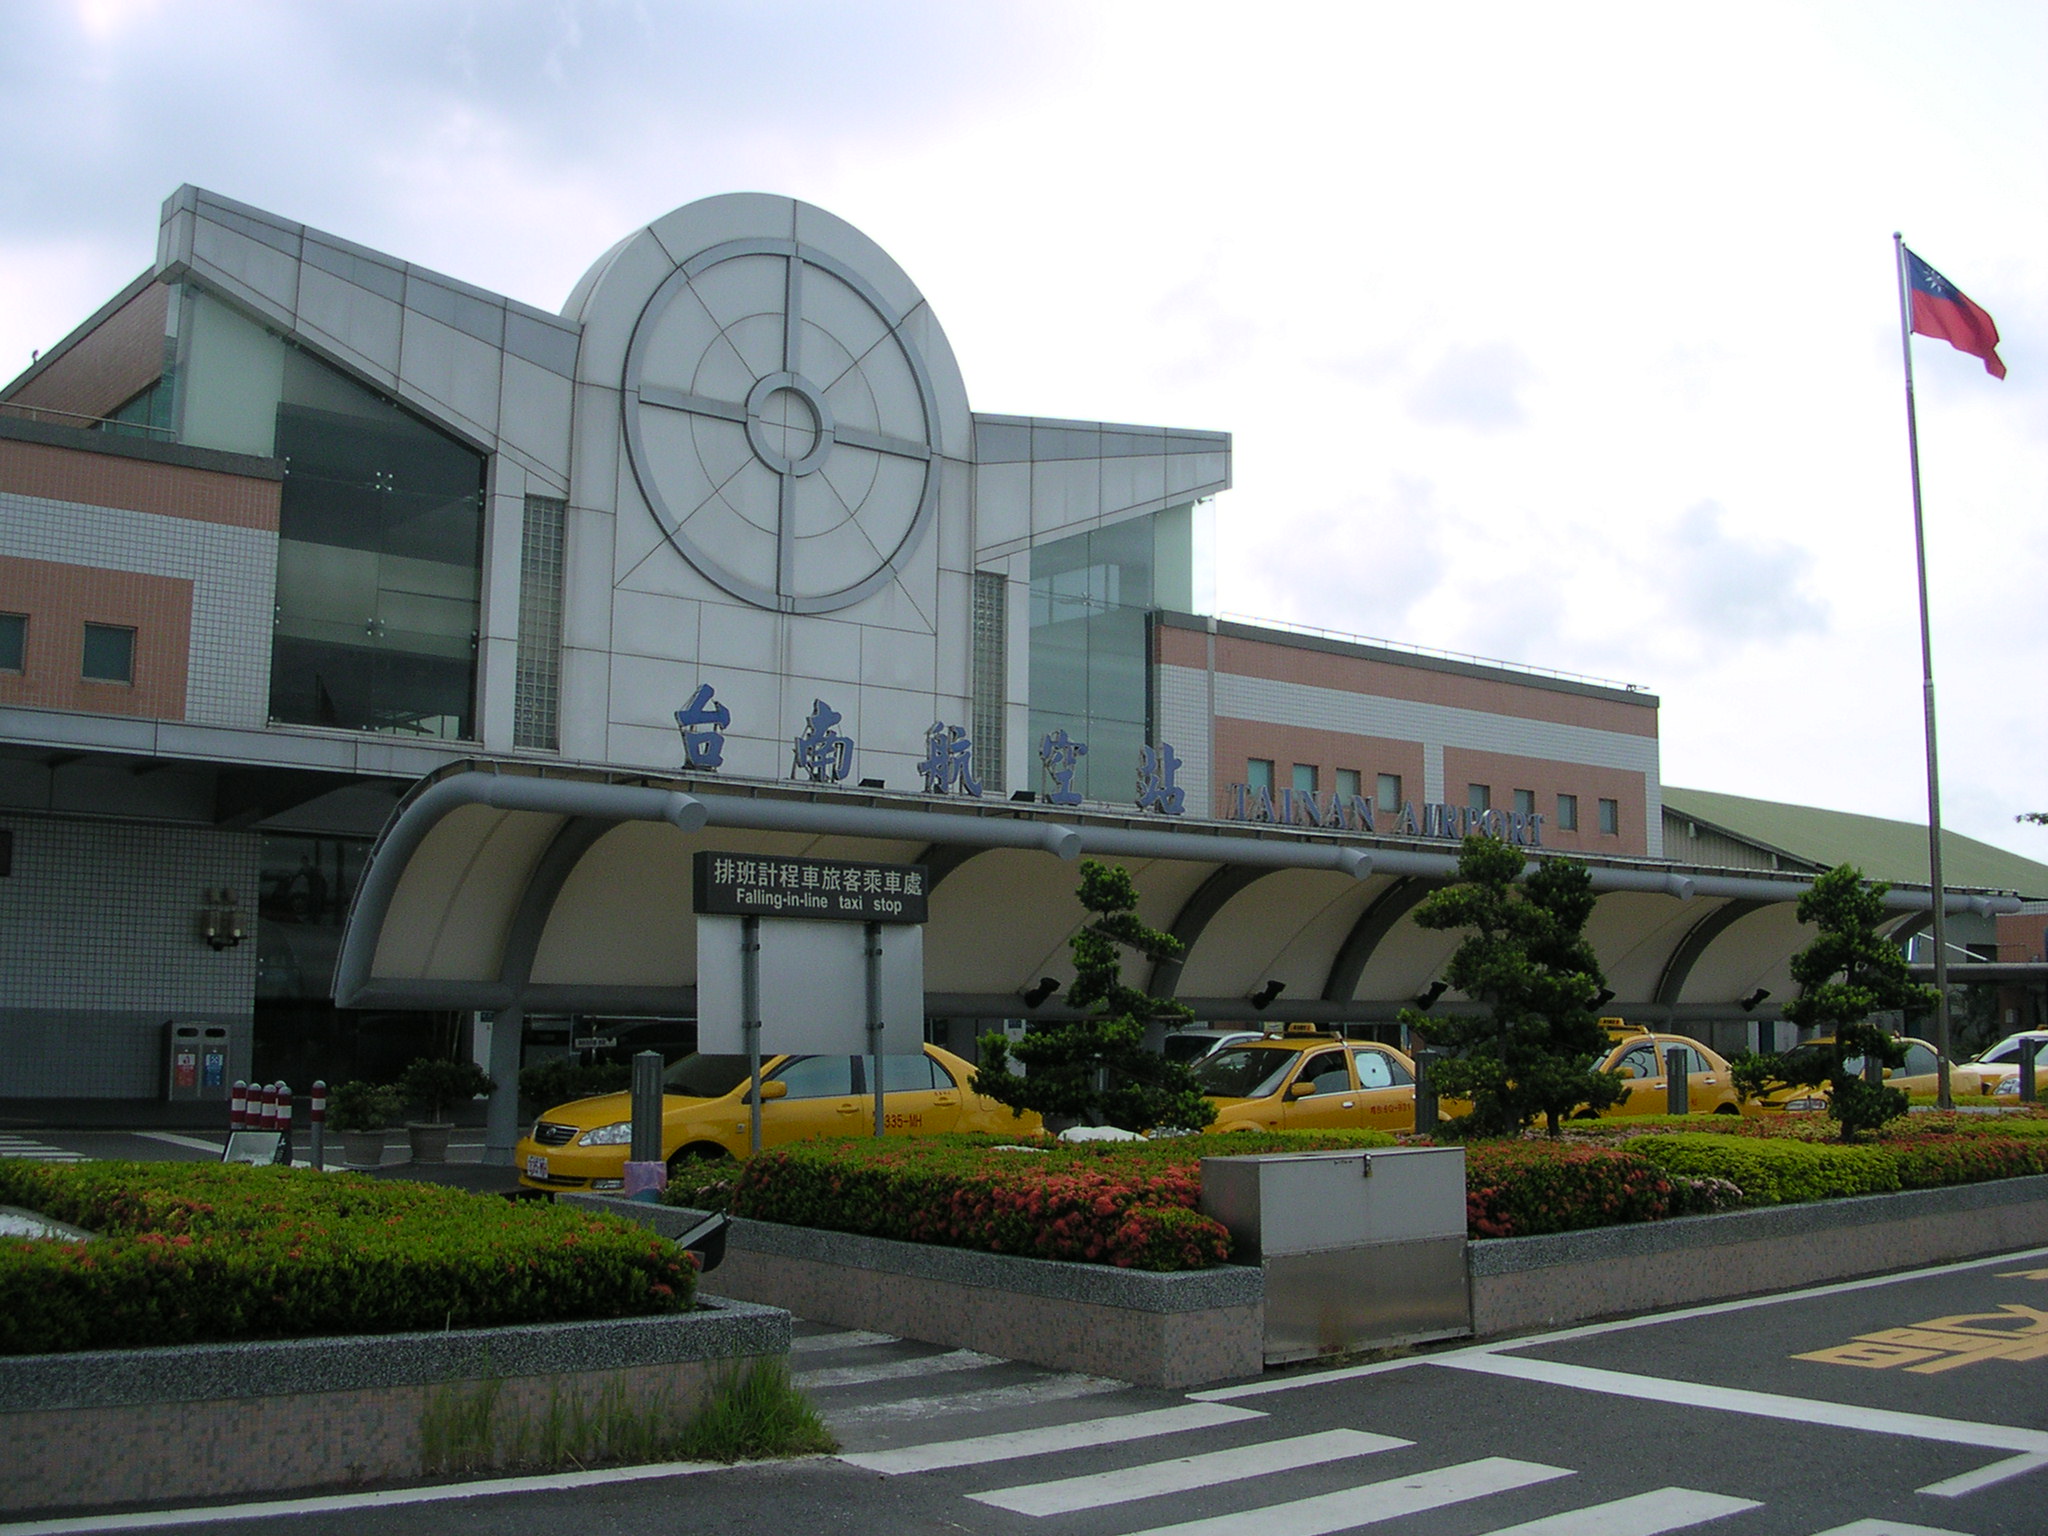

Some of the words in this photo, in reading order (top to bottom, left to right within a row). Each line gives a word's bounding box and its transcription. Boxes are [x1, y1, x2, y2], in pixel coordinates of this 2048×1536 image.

[675, 684, 1184, 815] 台南航空站
[1226, 783, 1374, 832] TAINAN
[1397, 801, 1545, 847] AIRPORT
[714, 858, 923, 896] 排班計程車旅客乘車處
[736, 887, 828, 909] Falling-in-line
[838, 895, 863, 911] taxi
[873, 898, 902, 915] stop
